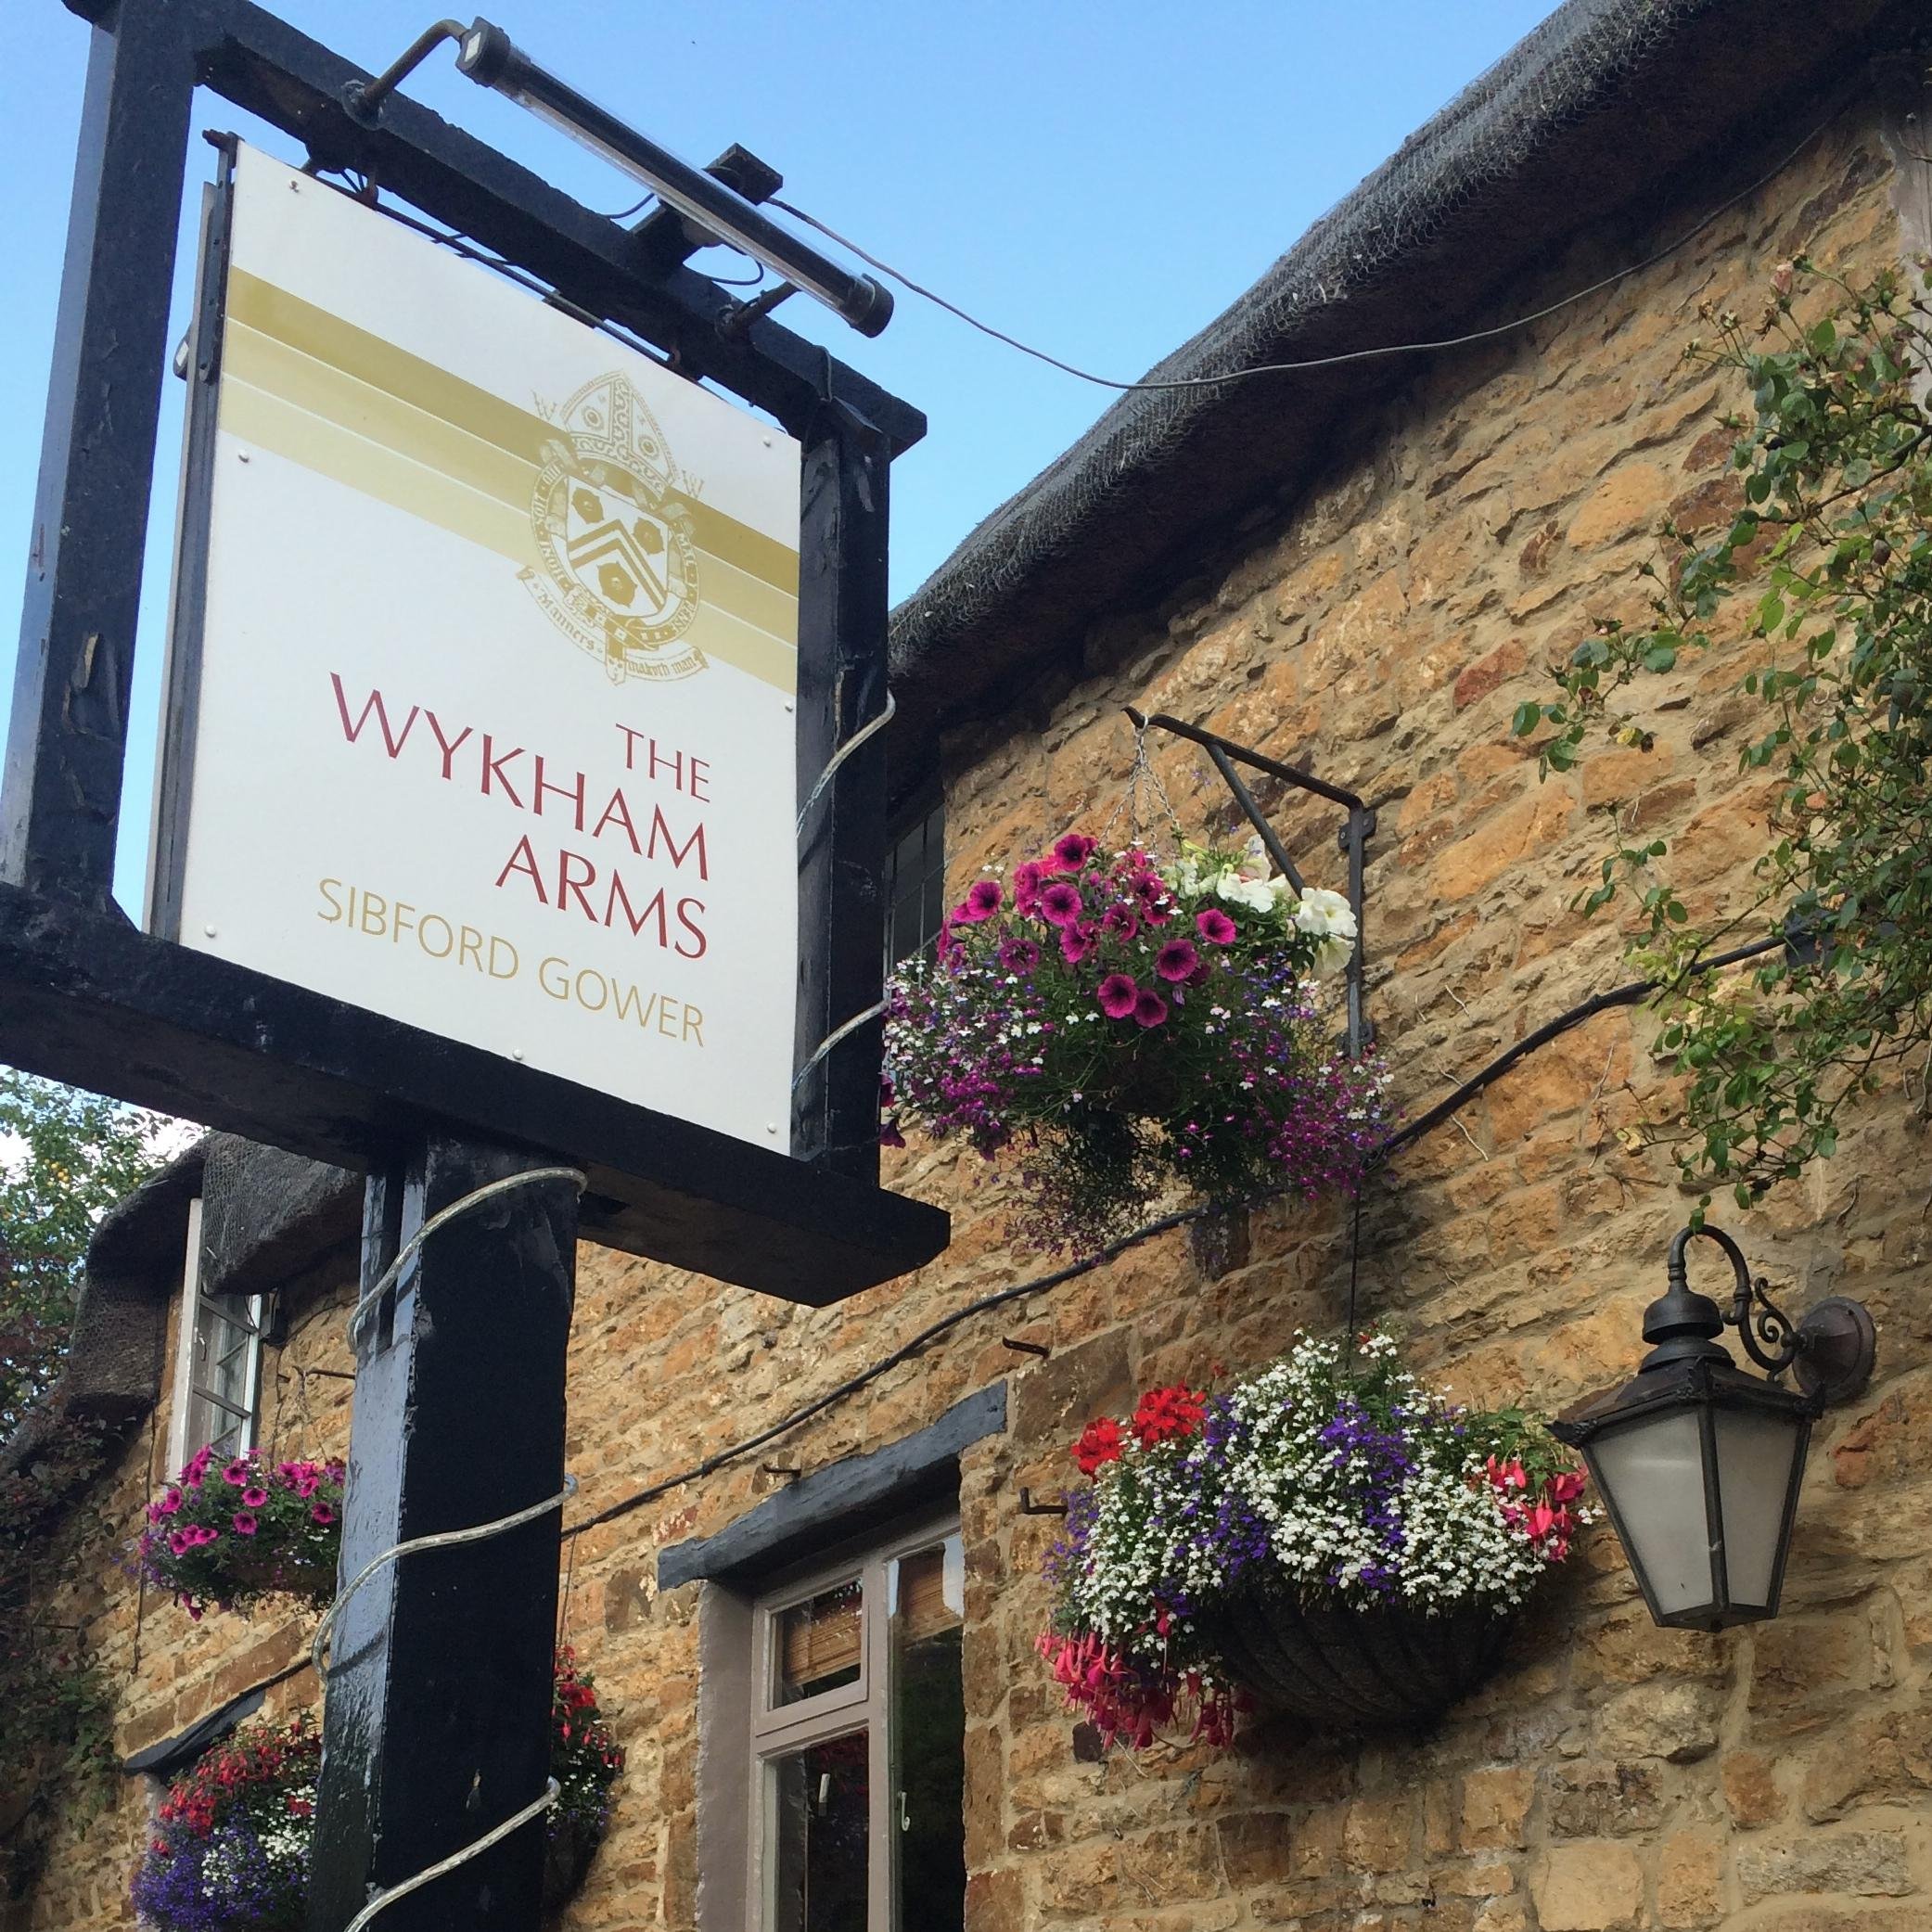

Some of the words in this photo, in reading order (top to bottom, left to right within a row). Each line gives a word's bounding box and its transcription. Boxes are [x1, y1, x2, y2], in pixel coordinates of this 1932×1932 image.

[331, 672, 709, 882] WYKHAM
[616, 723, 710, 803] THE
[317, 876, 519, 979] SIBFORD
[538, 956, 705, 1048] GOWER
[494, 835, 709, 961] ARMS
